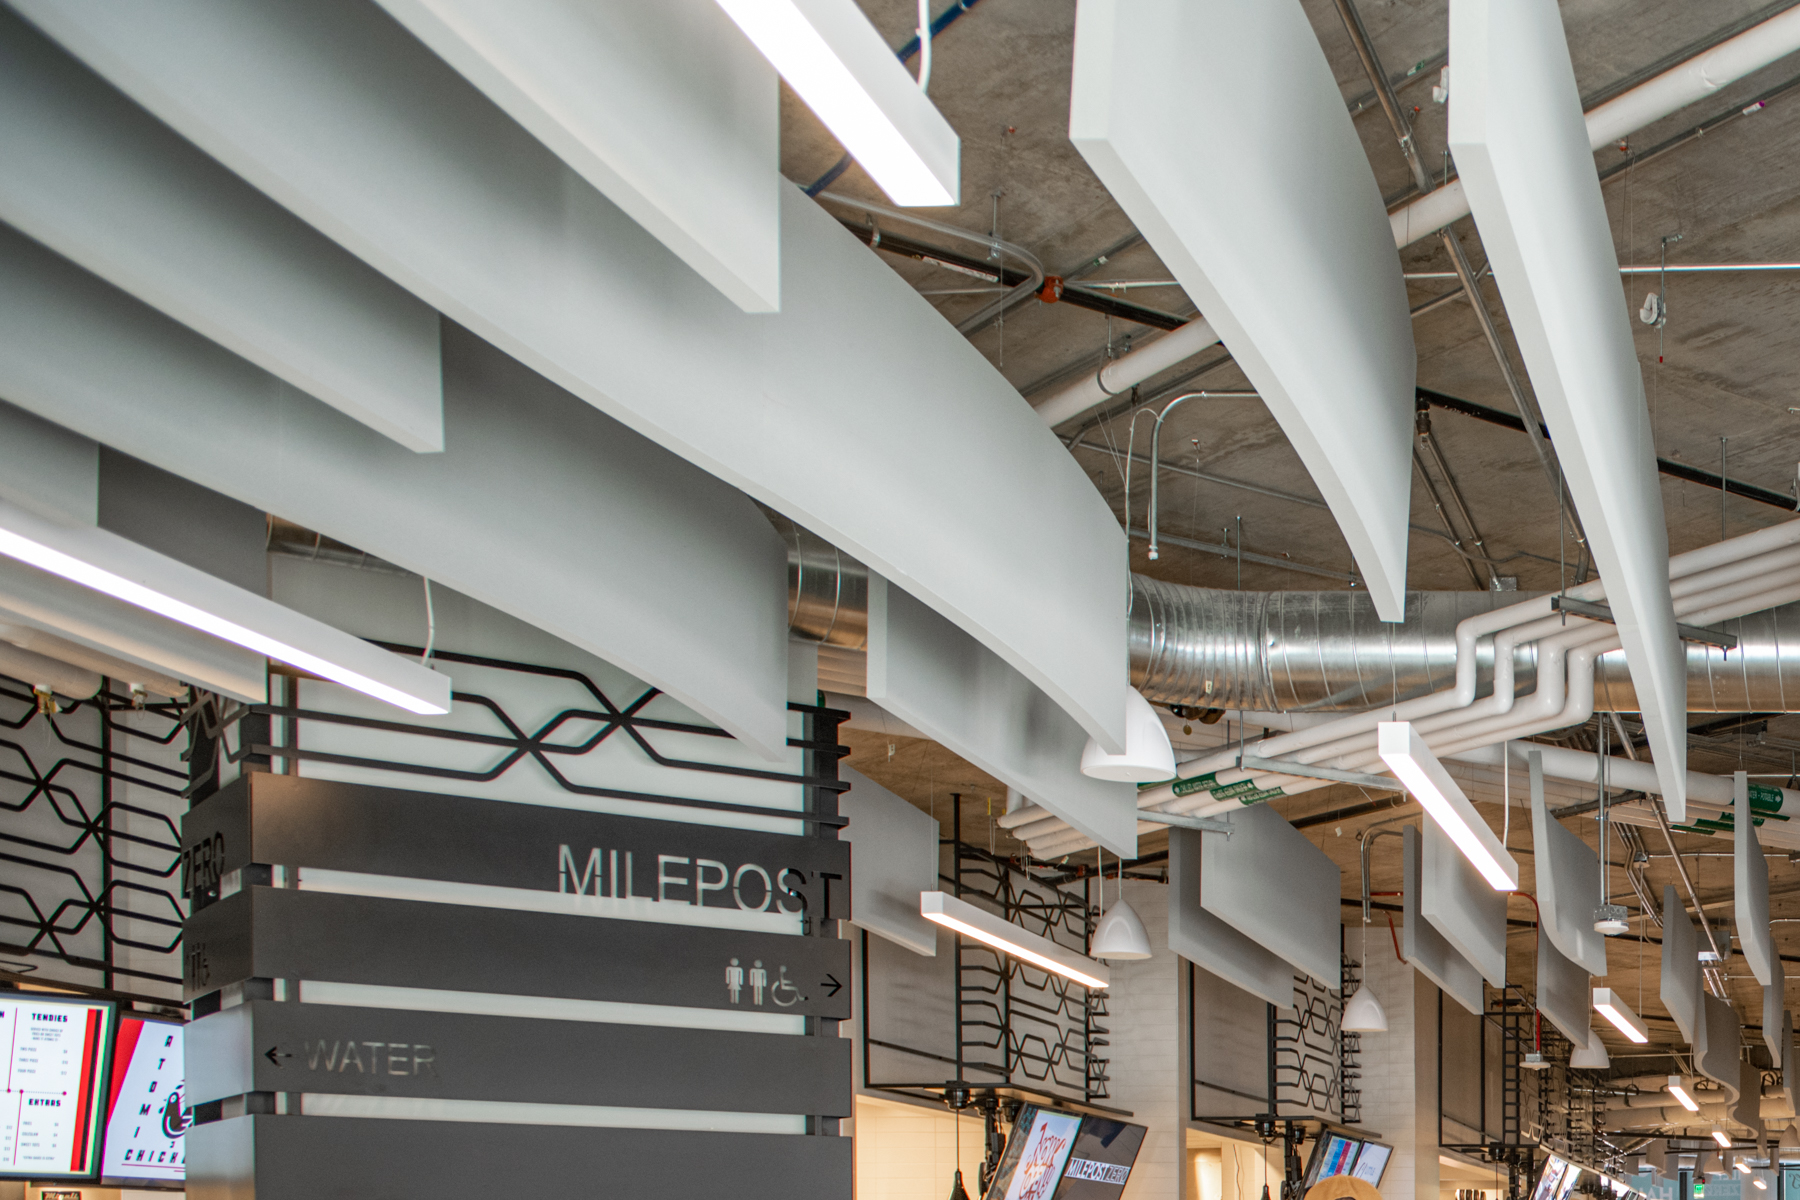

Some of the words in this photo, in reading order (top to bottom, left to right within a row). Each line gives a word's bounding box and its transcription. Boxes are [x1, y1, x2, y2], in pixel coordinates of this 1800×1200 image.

[184, 831, 225, 899] ZERO
[558, 843, 843, 920] MILEPOST
[31, 1012, 68, 1023] TENDIES
[303, 1039, 437, 1078] WATER
[28, 1098, 61, 1107] EXTRAS
[124, 1148, 186, 1164] CHICK
[1066, 1158, 1109, 1180] MILEPOST
[1105, 1165, 1130, 1184] ZERO
